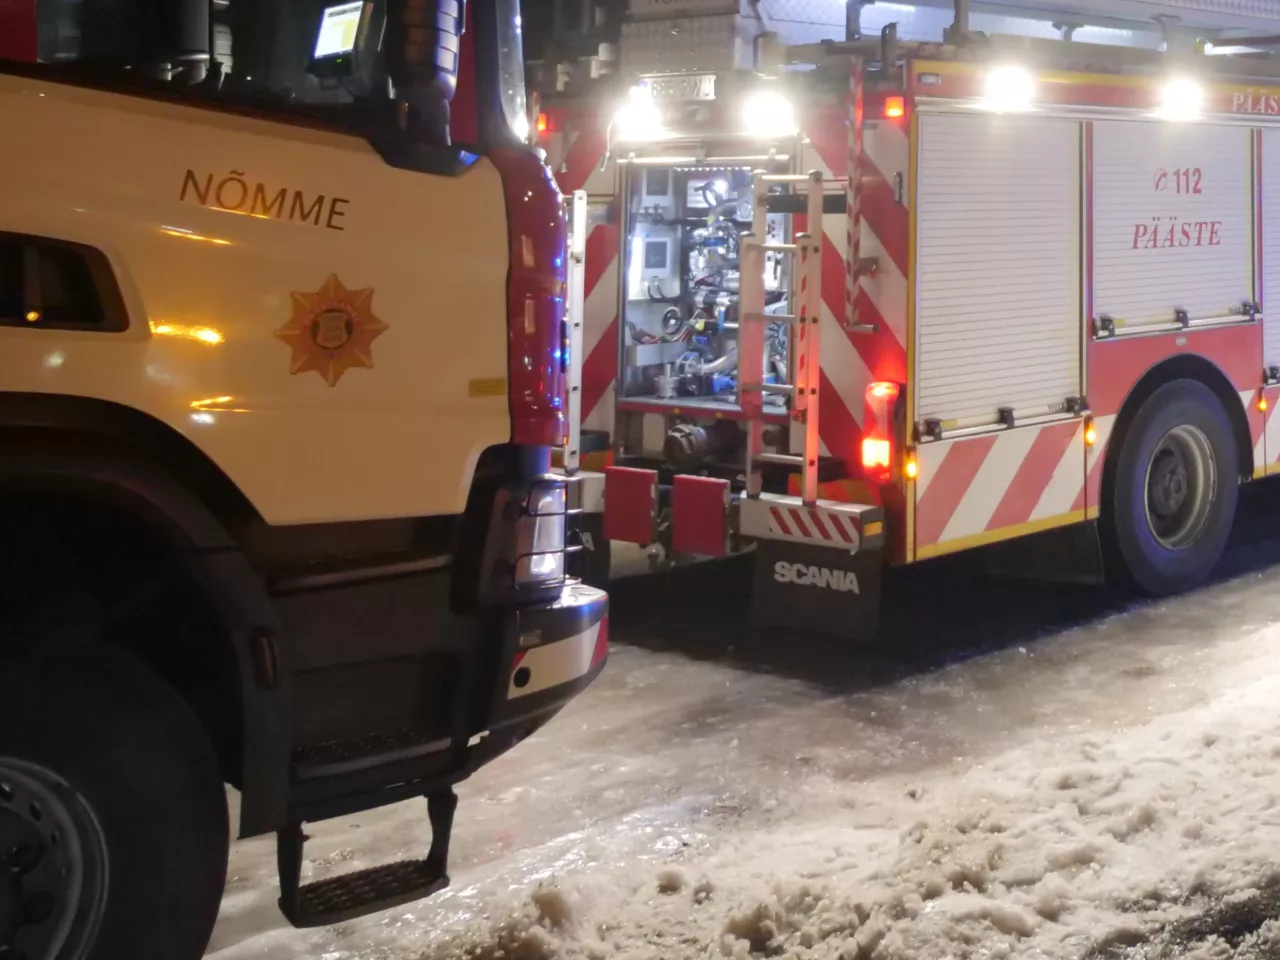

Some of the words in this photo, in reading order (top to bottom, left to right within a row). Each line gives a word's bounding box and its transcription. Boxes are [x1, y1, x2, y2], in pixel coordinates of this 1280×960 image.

[1173, 167, 1202, 194] 112
[179, 168, 350, 231] NÕMME
[1131, 216, 1222, 249] PÄÄSTE
[774, 561, 860, 594] SCANIA
